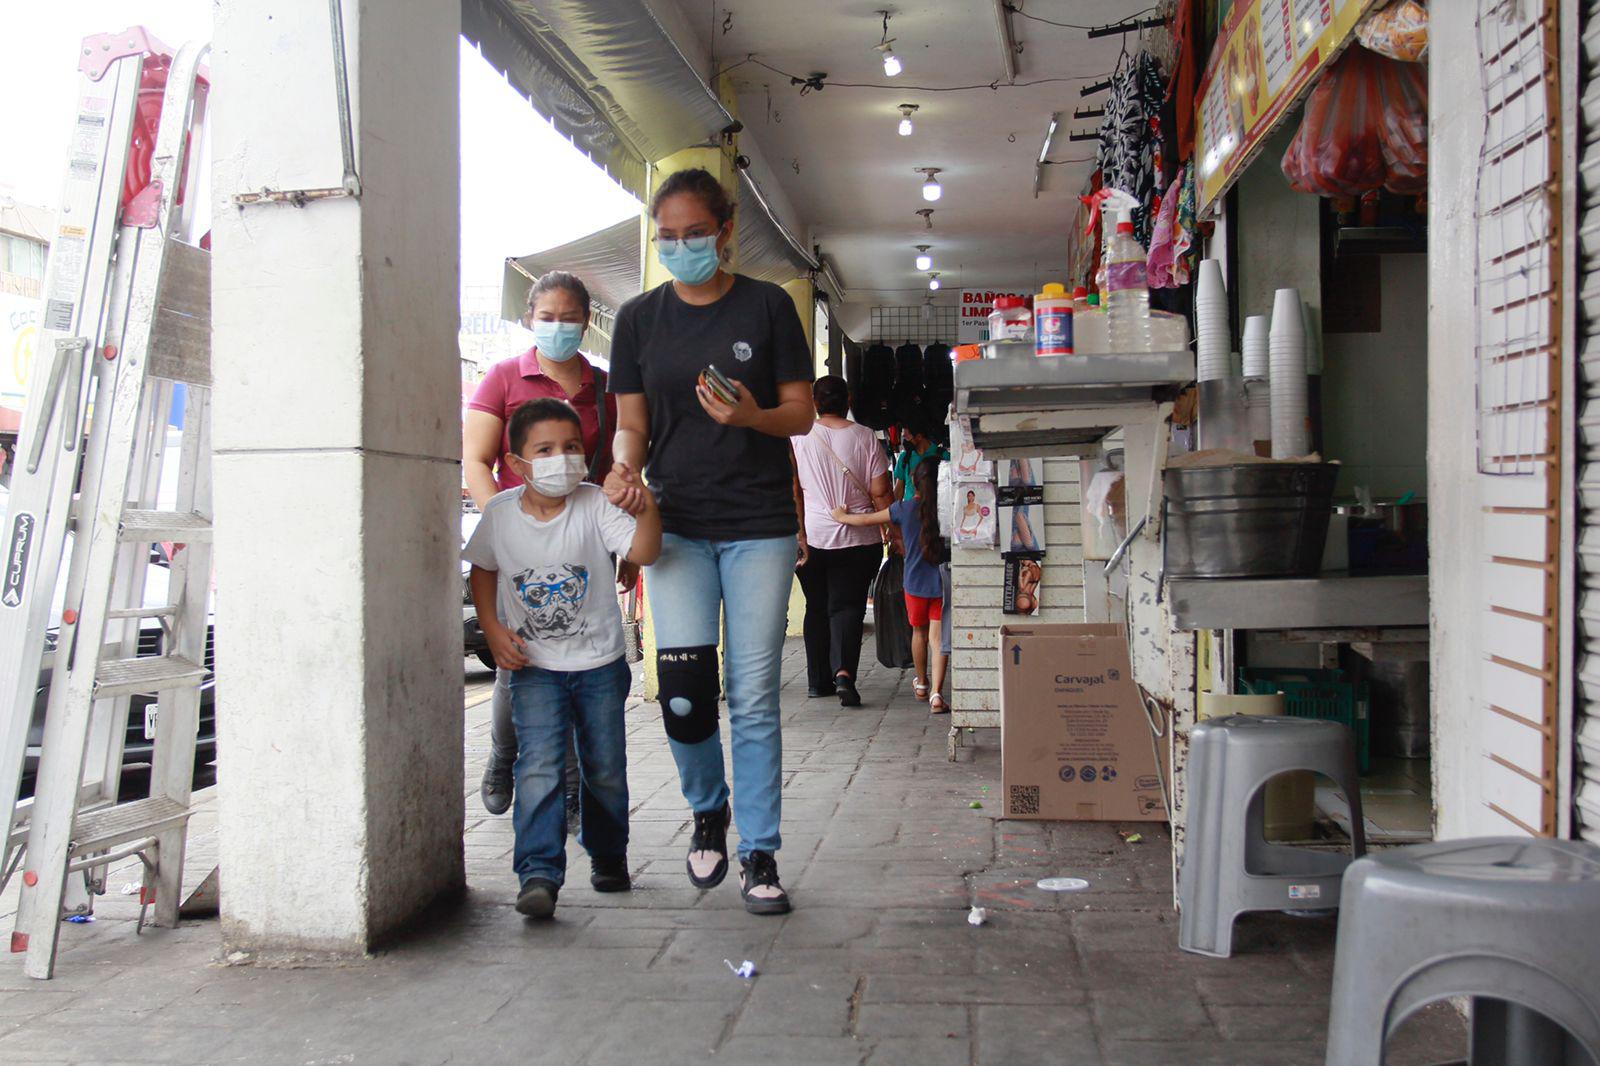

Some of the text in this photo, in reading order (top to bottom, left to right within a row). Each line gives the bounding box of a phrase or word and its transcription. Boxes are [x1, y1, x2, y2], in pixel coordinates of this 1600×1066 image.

[12, 515, 31, 586] CUPRUM
[1004, 563, 1014, 611] BUTTRAISER
[1055, 674, 1105, 686] Carvajal
